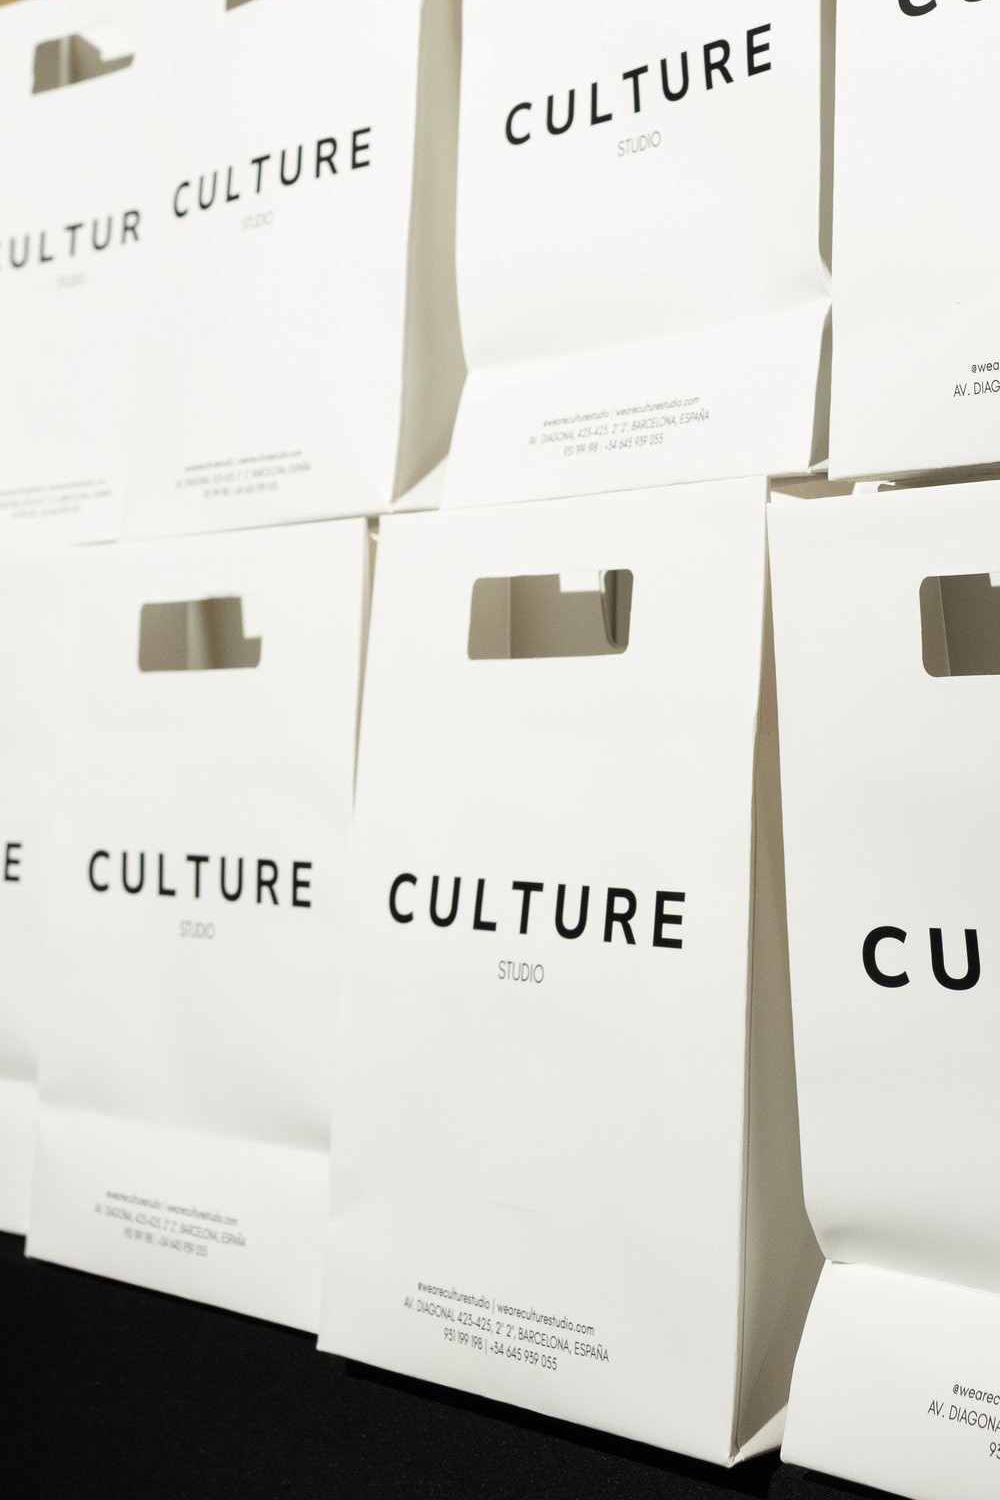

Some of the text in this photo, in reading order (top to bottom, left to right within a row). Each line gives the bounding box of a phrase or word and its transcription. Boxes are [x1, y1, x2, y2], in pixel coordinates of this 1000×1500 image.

[505, 23, 772, 145] CULTURE
[617, 131, 662, 157] STUDIO
[173, 127, 372, 218] CULTURE
[0, 209, 141, 271] ULTUR
[953, 383, 970, 397] AV.
[88, 850, 312, 908] CULTURE
[388, 873, 686, 949] CULTURE
[498, 960, 545, 984] STUDIO
[417, 1299, 455, 1322] DIAGONAL
[518, 1327, 572, 1355] BARCELONA,
[574, 1341, 609, 1362] ESPAÑA
[497, 1303, 595, 1336] weareculturestudio.com
[458, 1330, 469, 1345] 199
[471, 1335, 483, 1350] 198
[506, 1345, 522, 1361] 645
[523, 1349, 539, 1365] 939
[541, 1354, 558, 1371] 055
[927, 1399, 945, 1418] AV.
